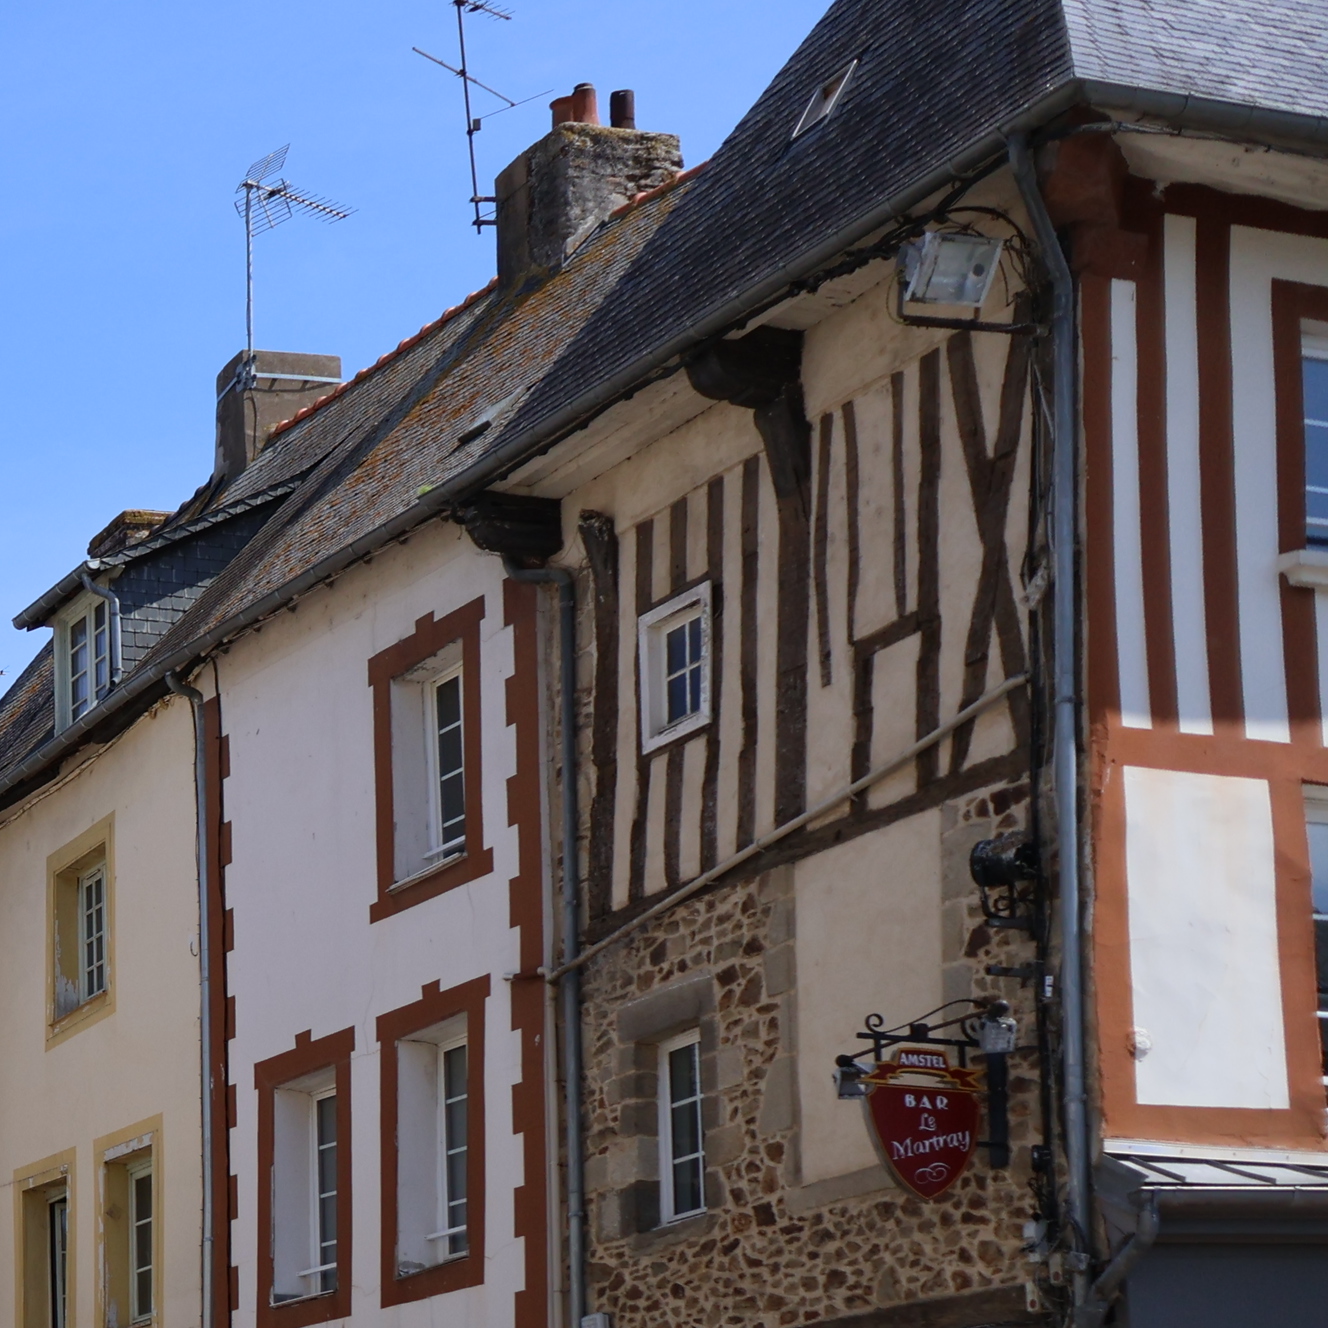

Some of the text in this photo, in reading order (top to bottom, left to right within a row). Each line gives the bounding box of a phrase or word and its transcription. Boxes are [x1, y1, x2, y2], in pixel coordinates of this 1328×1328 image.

[899, 1052, 946, 1068] AMSTEL
[904, 1093, 949, 1110] BAR
[918, 1112, 937, 1131] Le
[891, 1130, 971, 1160] Martray
